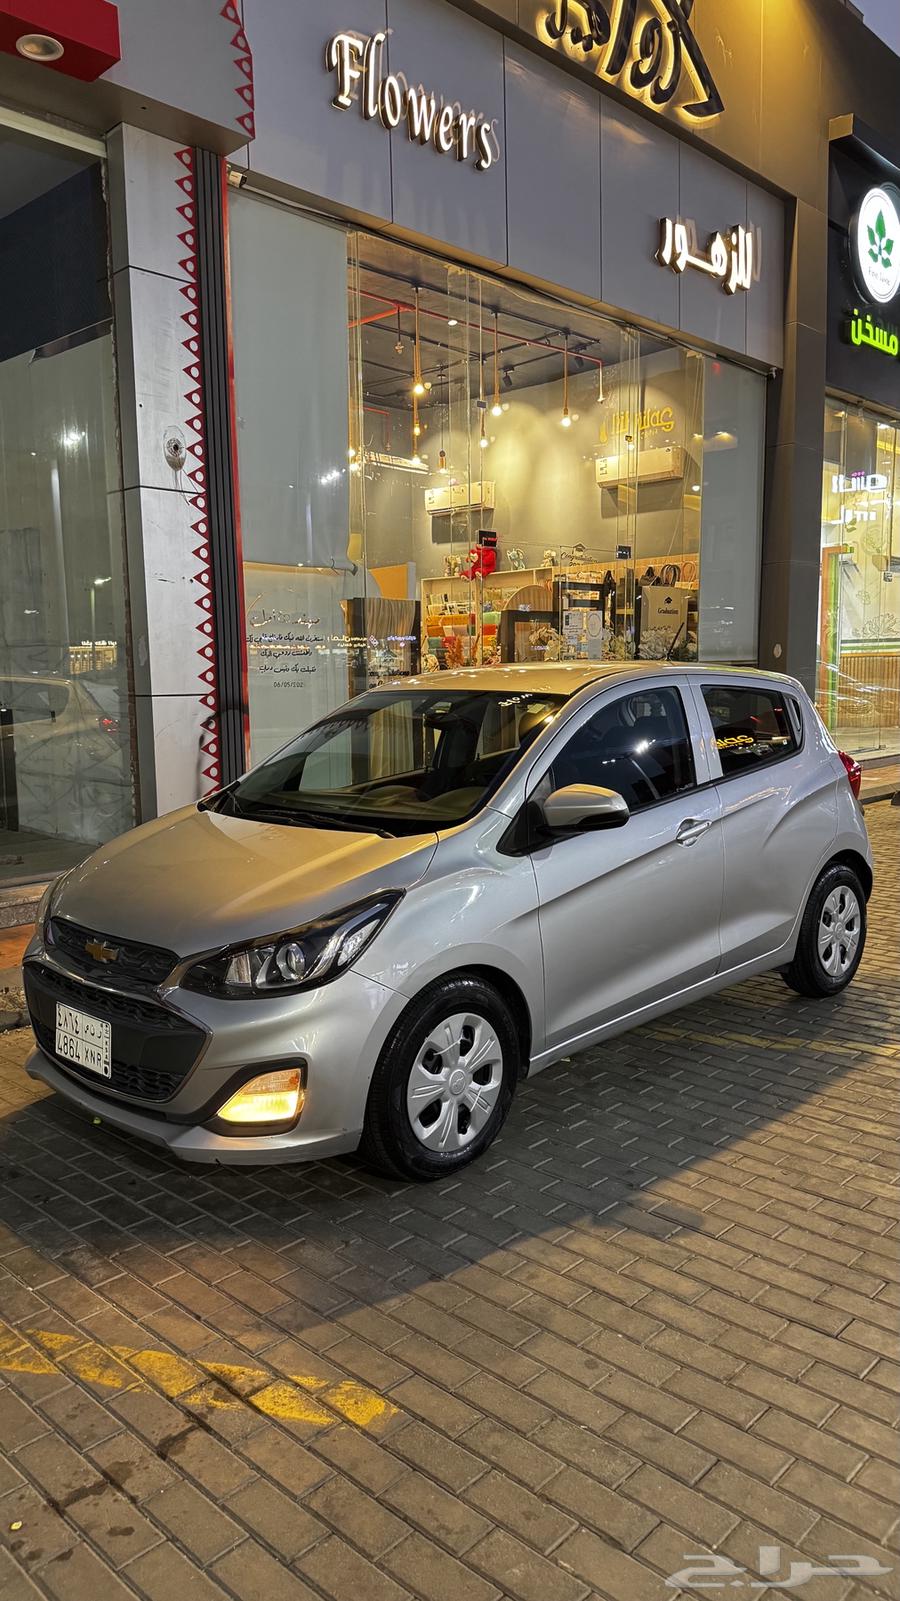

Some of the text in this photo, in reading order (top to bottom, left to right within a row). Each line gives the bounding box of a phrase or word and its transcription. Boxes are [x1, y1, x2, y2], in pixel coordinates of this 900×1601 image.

[326, 32, 493, 171] Flowers
[656, 217, 753, 295] للزهور
[851, 308, 899, 356] مسخن
[57, 1033, 102, 1067] 4864 XNR
